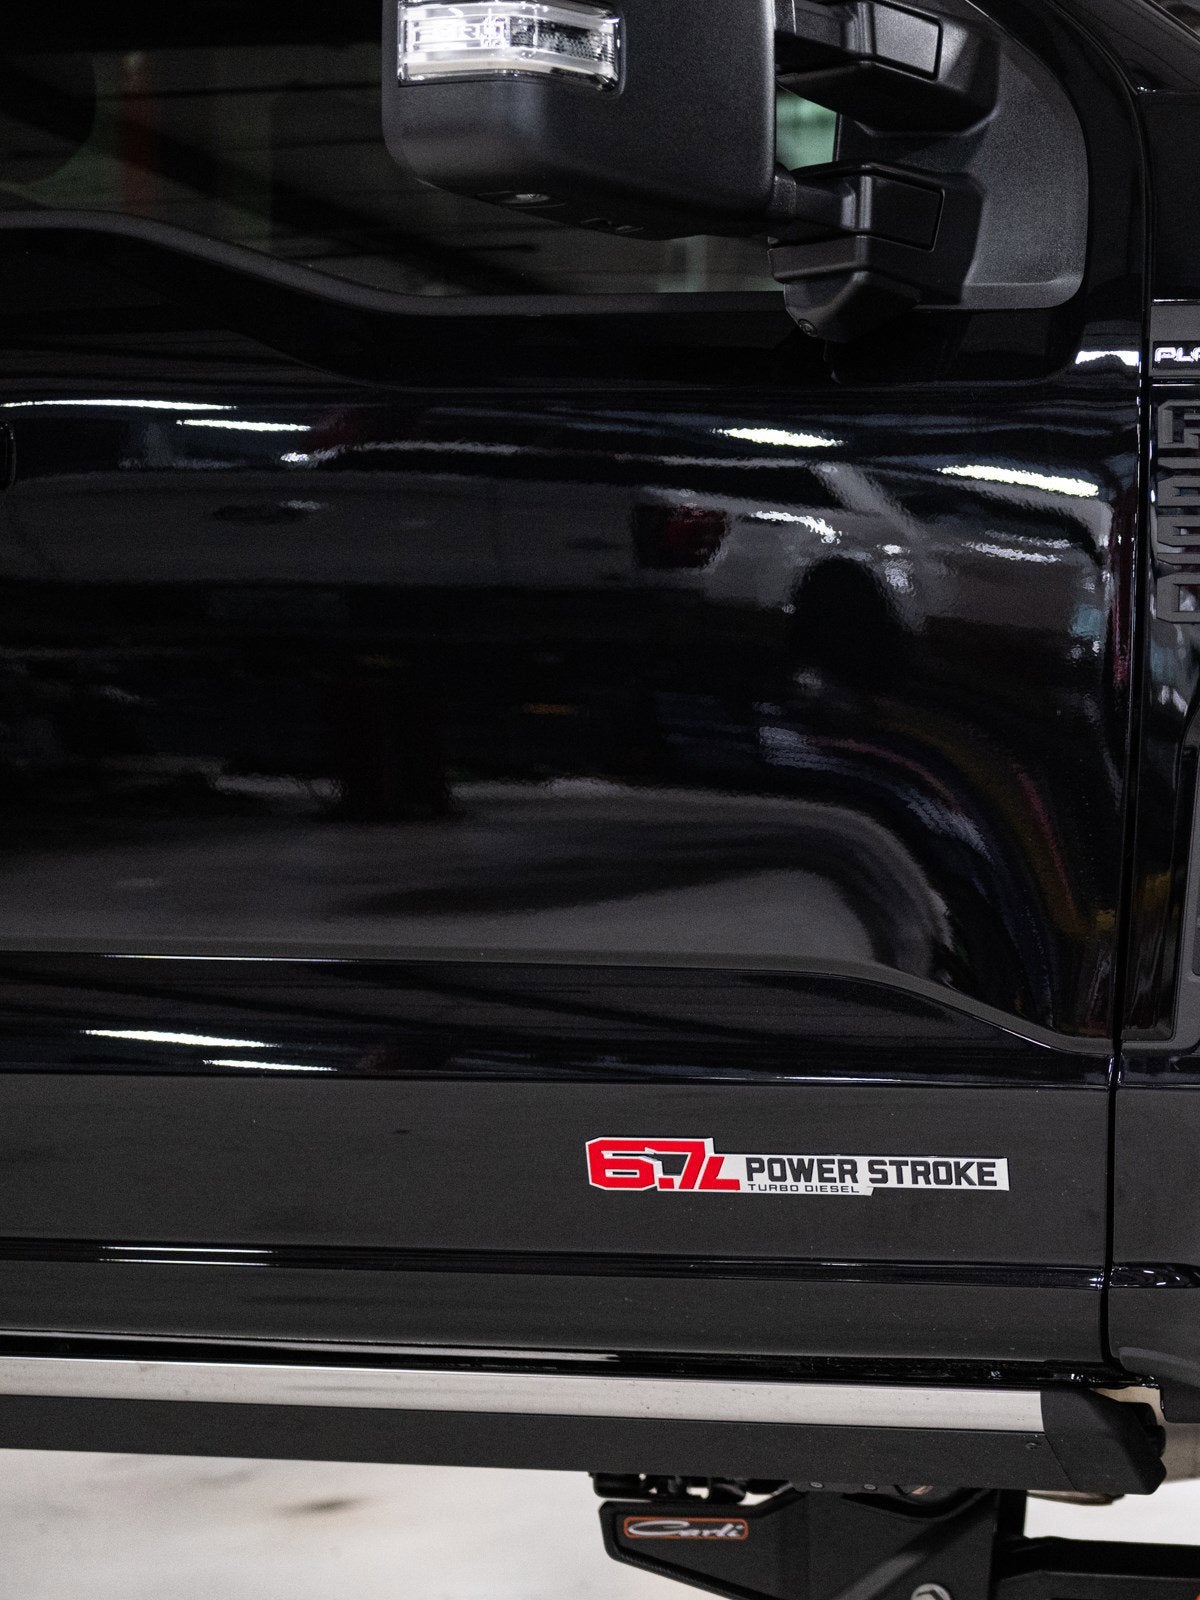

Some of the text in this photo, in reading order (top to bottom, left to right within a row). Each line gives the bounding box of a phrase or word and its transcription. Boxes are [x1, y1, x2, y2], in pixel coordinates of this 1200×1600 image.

[587, 1138, 998, 1191] 6.7L POWER STROKE
[747, 1183, 860, 1194] TURBO DIESEL
[628, 1520, 745, 1536] Carli
